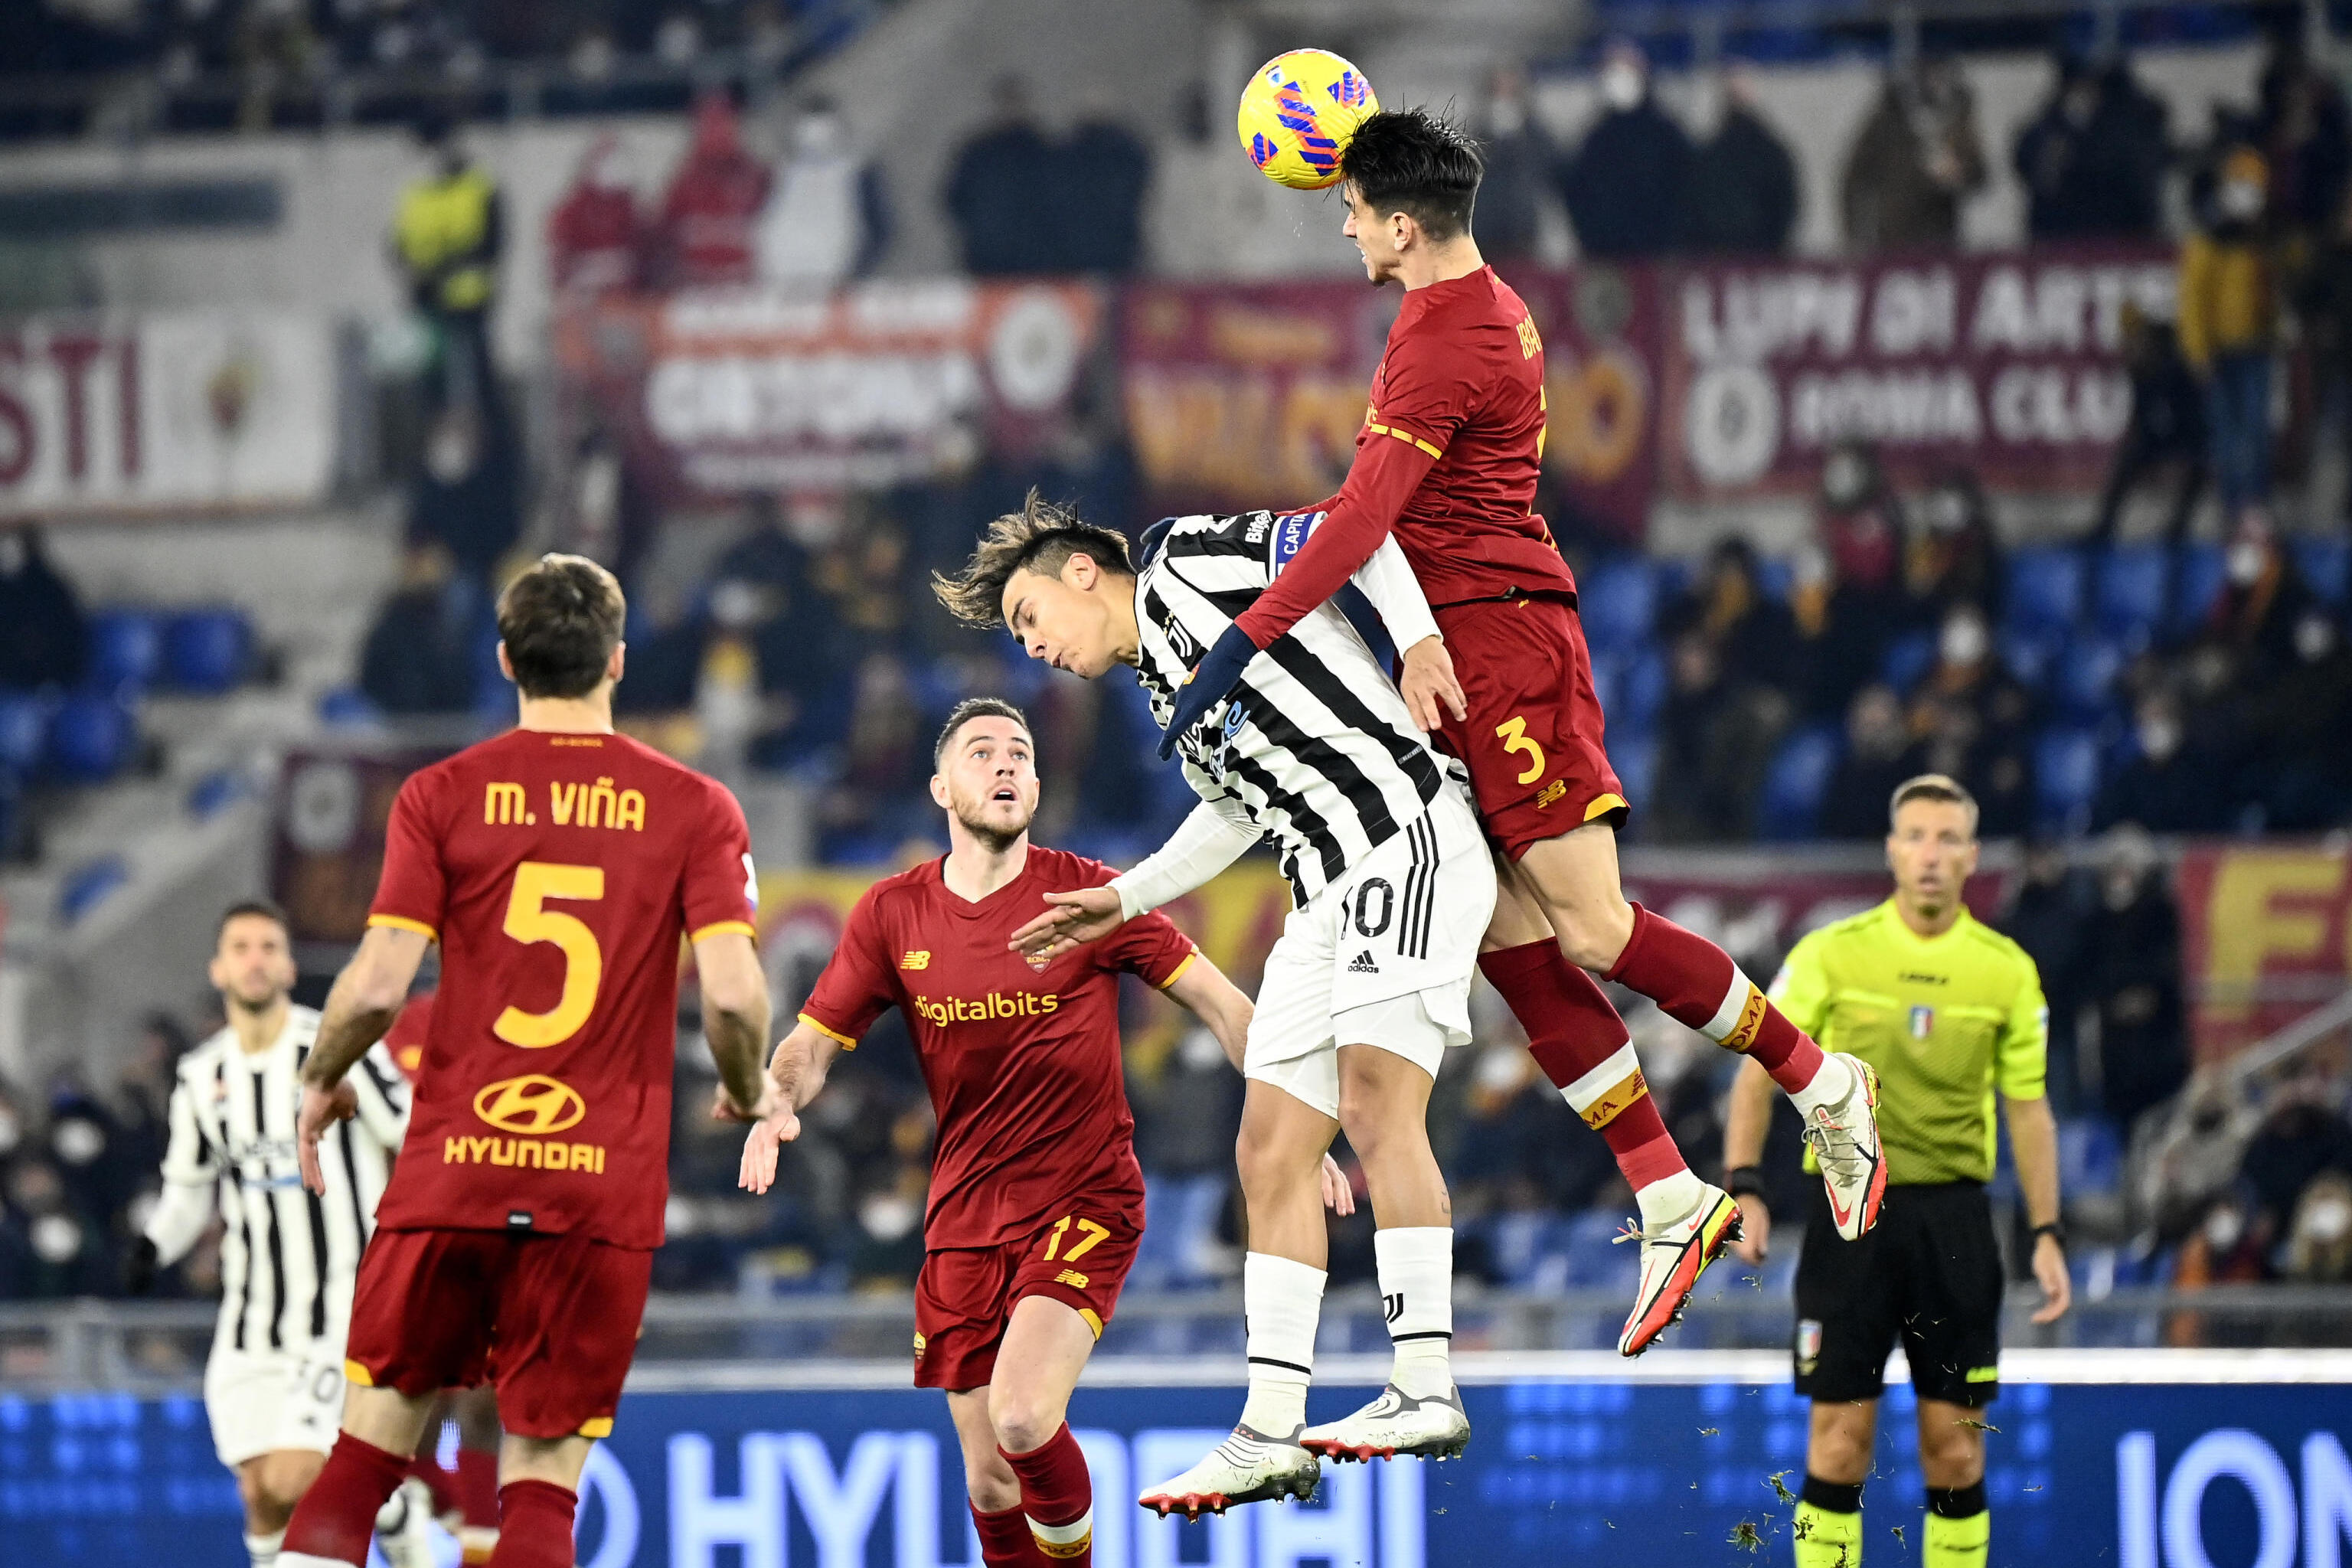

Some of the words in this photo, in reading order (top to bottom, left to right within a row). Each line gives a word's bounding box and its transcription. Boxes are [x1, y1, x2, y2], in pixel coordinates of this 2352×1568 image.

[1495, 715, 1546, 785] 3
[484, 782, 536, 826] M.
[550, 776, 646, 832] VIÑA
[492, 861, 605, 1049] 5
[1348, 962, 1380, 974] adidas
[915, 991, 1059, 1027] digitalbits
[443, 1135, 606, 1175] HYUNDAI
[1042, 1215, 1111, 1263] 17
